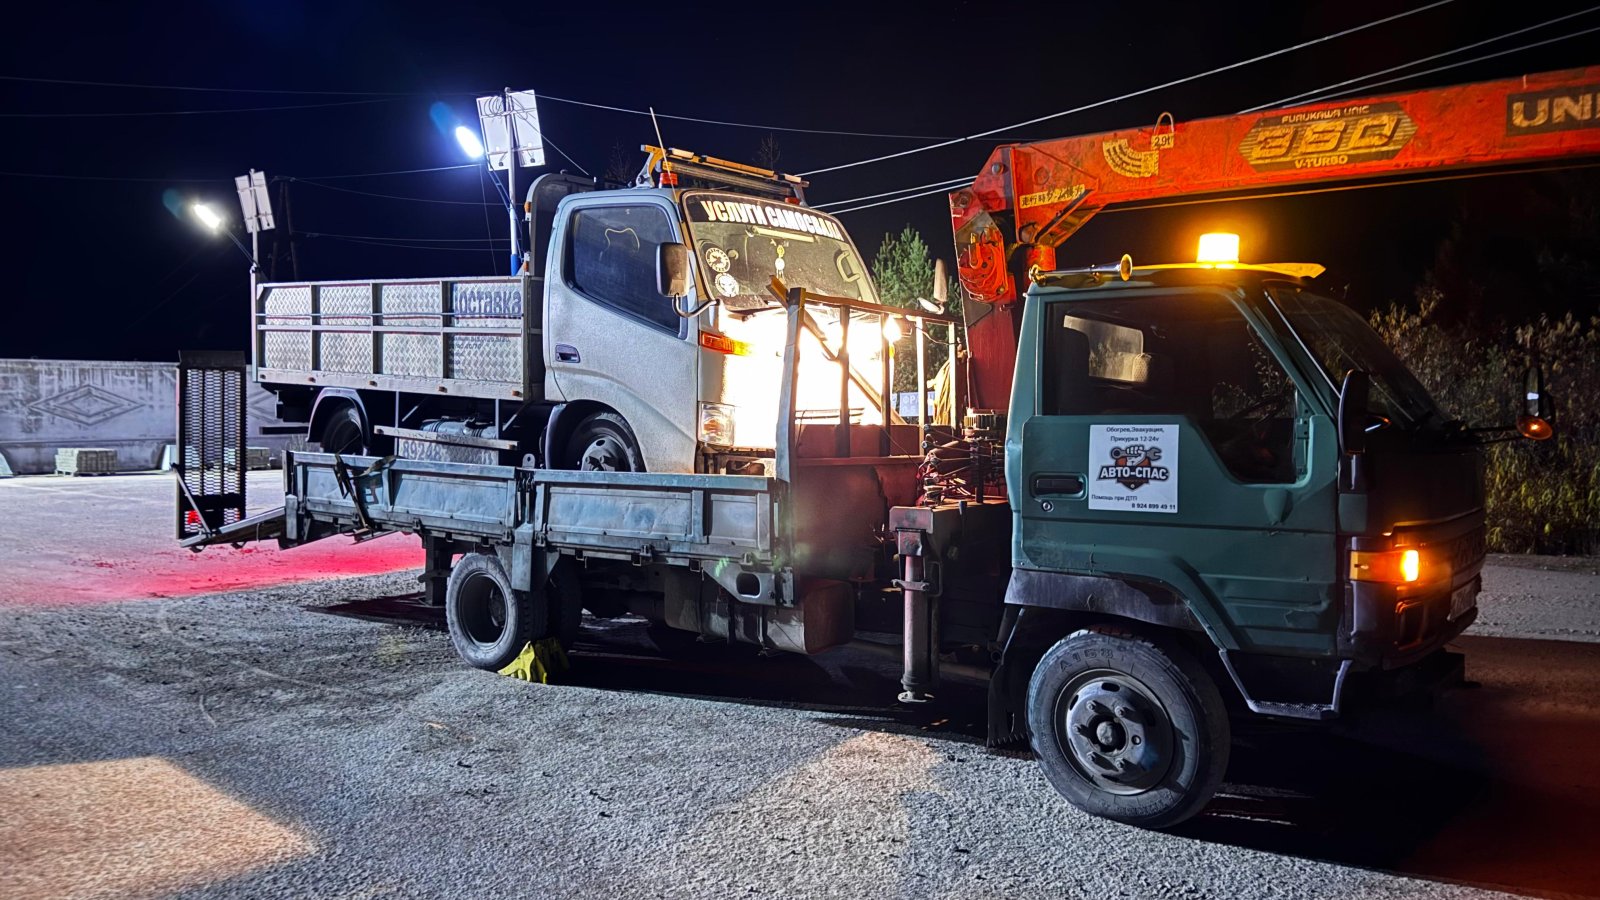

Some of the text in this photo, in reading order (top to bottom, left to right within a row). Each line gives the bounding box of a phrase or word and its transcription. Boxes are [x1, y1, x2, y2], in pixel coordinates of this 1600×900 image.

[1281, 109, 1341, 124] FURUKAWA
[1294, 155, 1349, 169] V-TURBO
[700, 200, 845, 242] УСЛУГИ САМОСВАЛА
[1100, 466, 1167, 480] АВТО-СПАС
